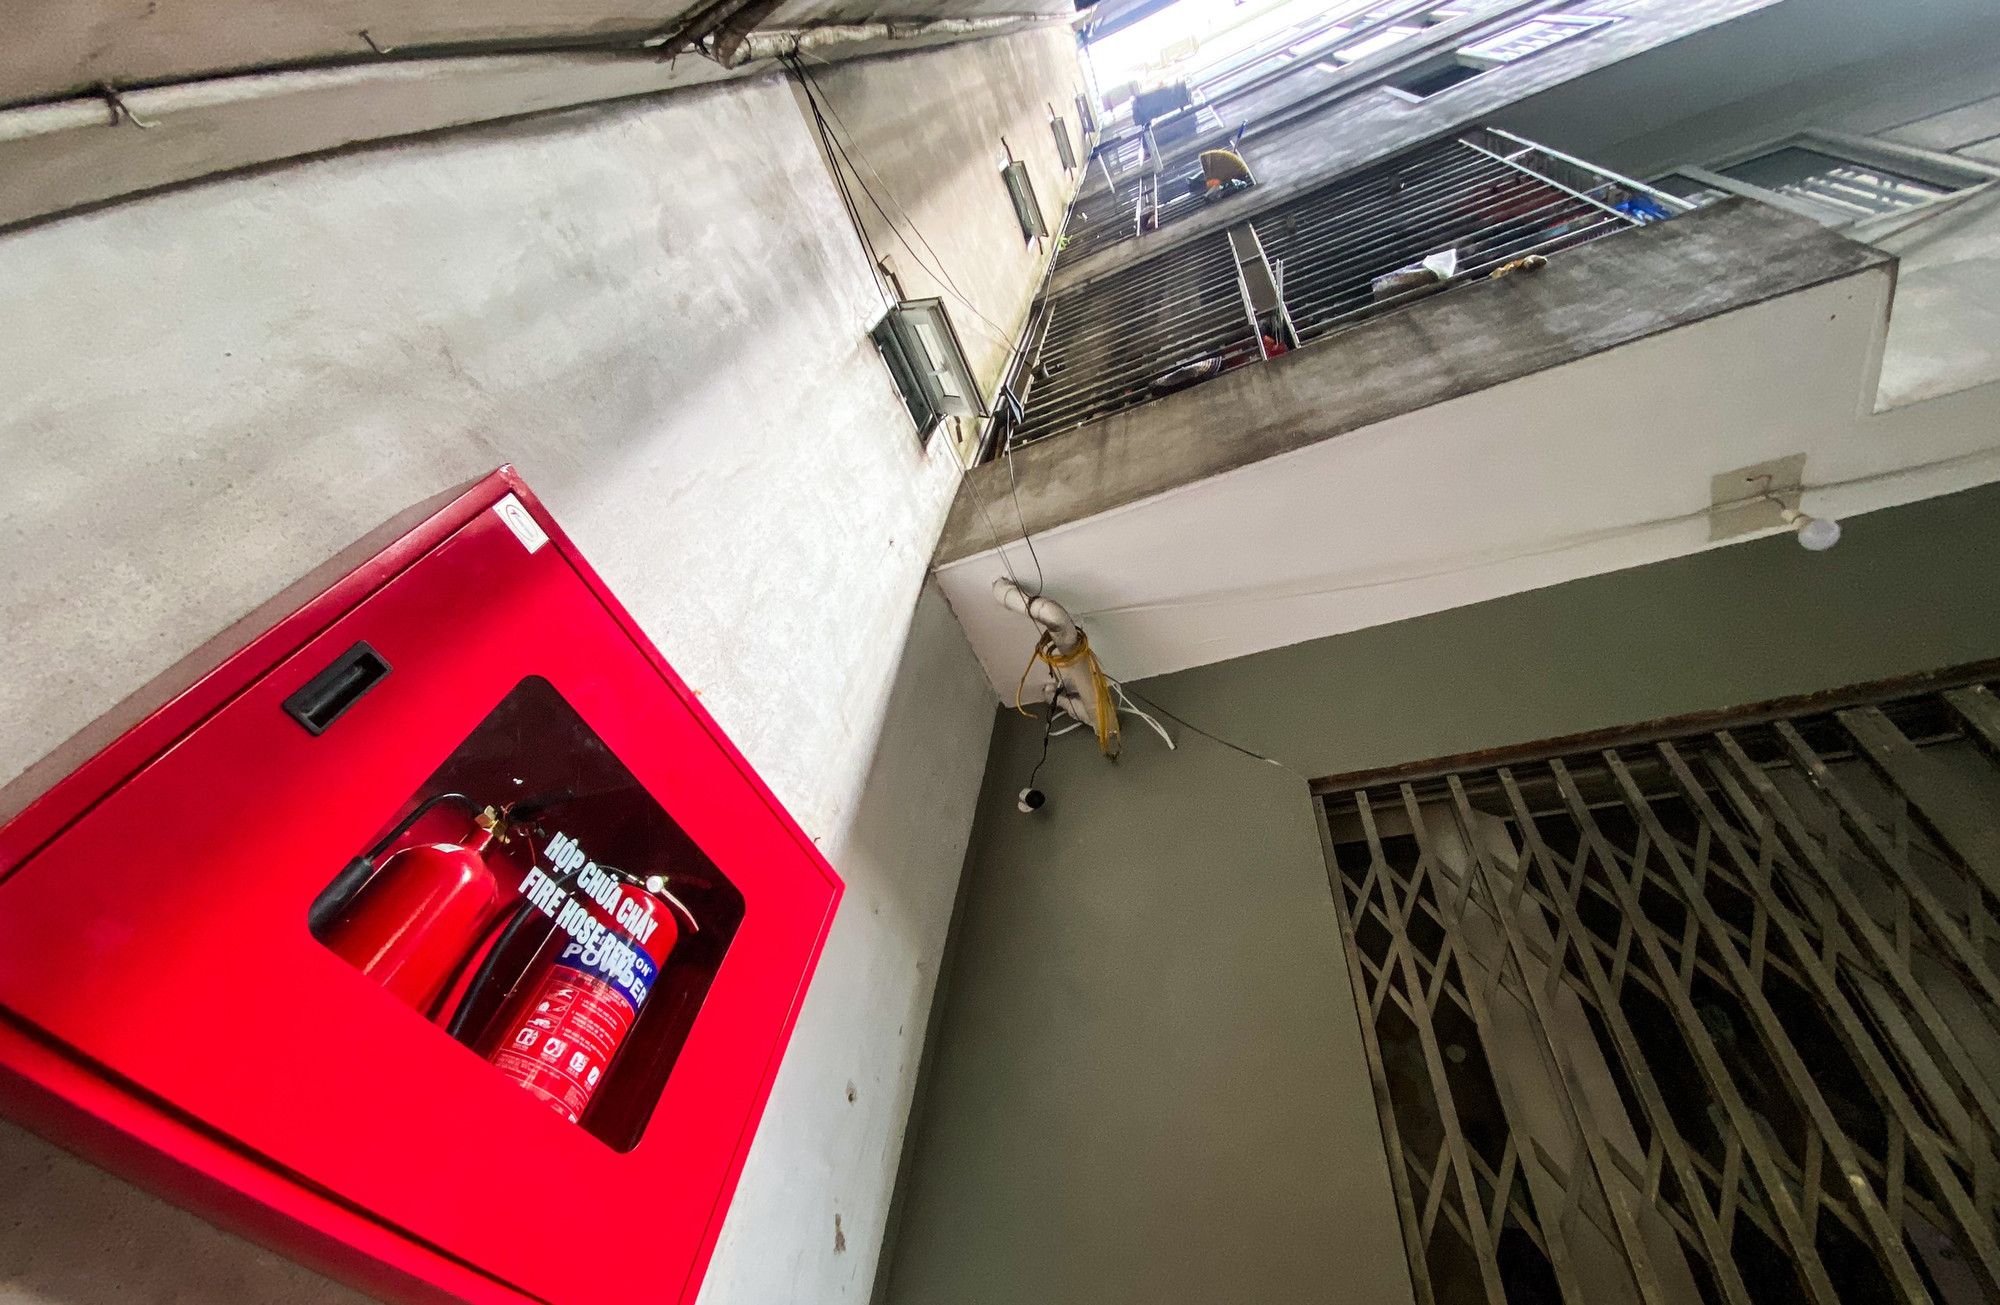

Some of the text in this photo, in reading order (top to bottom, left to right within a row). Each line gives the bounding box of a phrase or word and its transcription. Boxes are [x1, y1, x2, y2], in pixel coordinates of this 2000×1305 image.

[518, 865, 567, 918] FIRE
[555, 897, 606, 950] HOSE
[543, 831, 586, 875] HỘP
[577, 861, 623, 916] CHỮA
[562, 943, 647, 1009] POWDER
